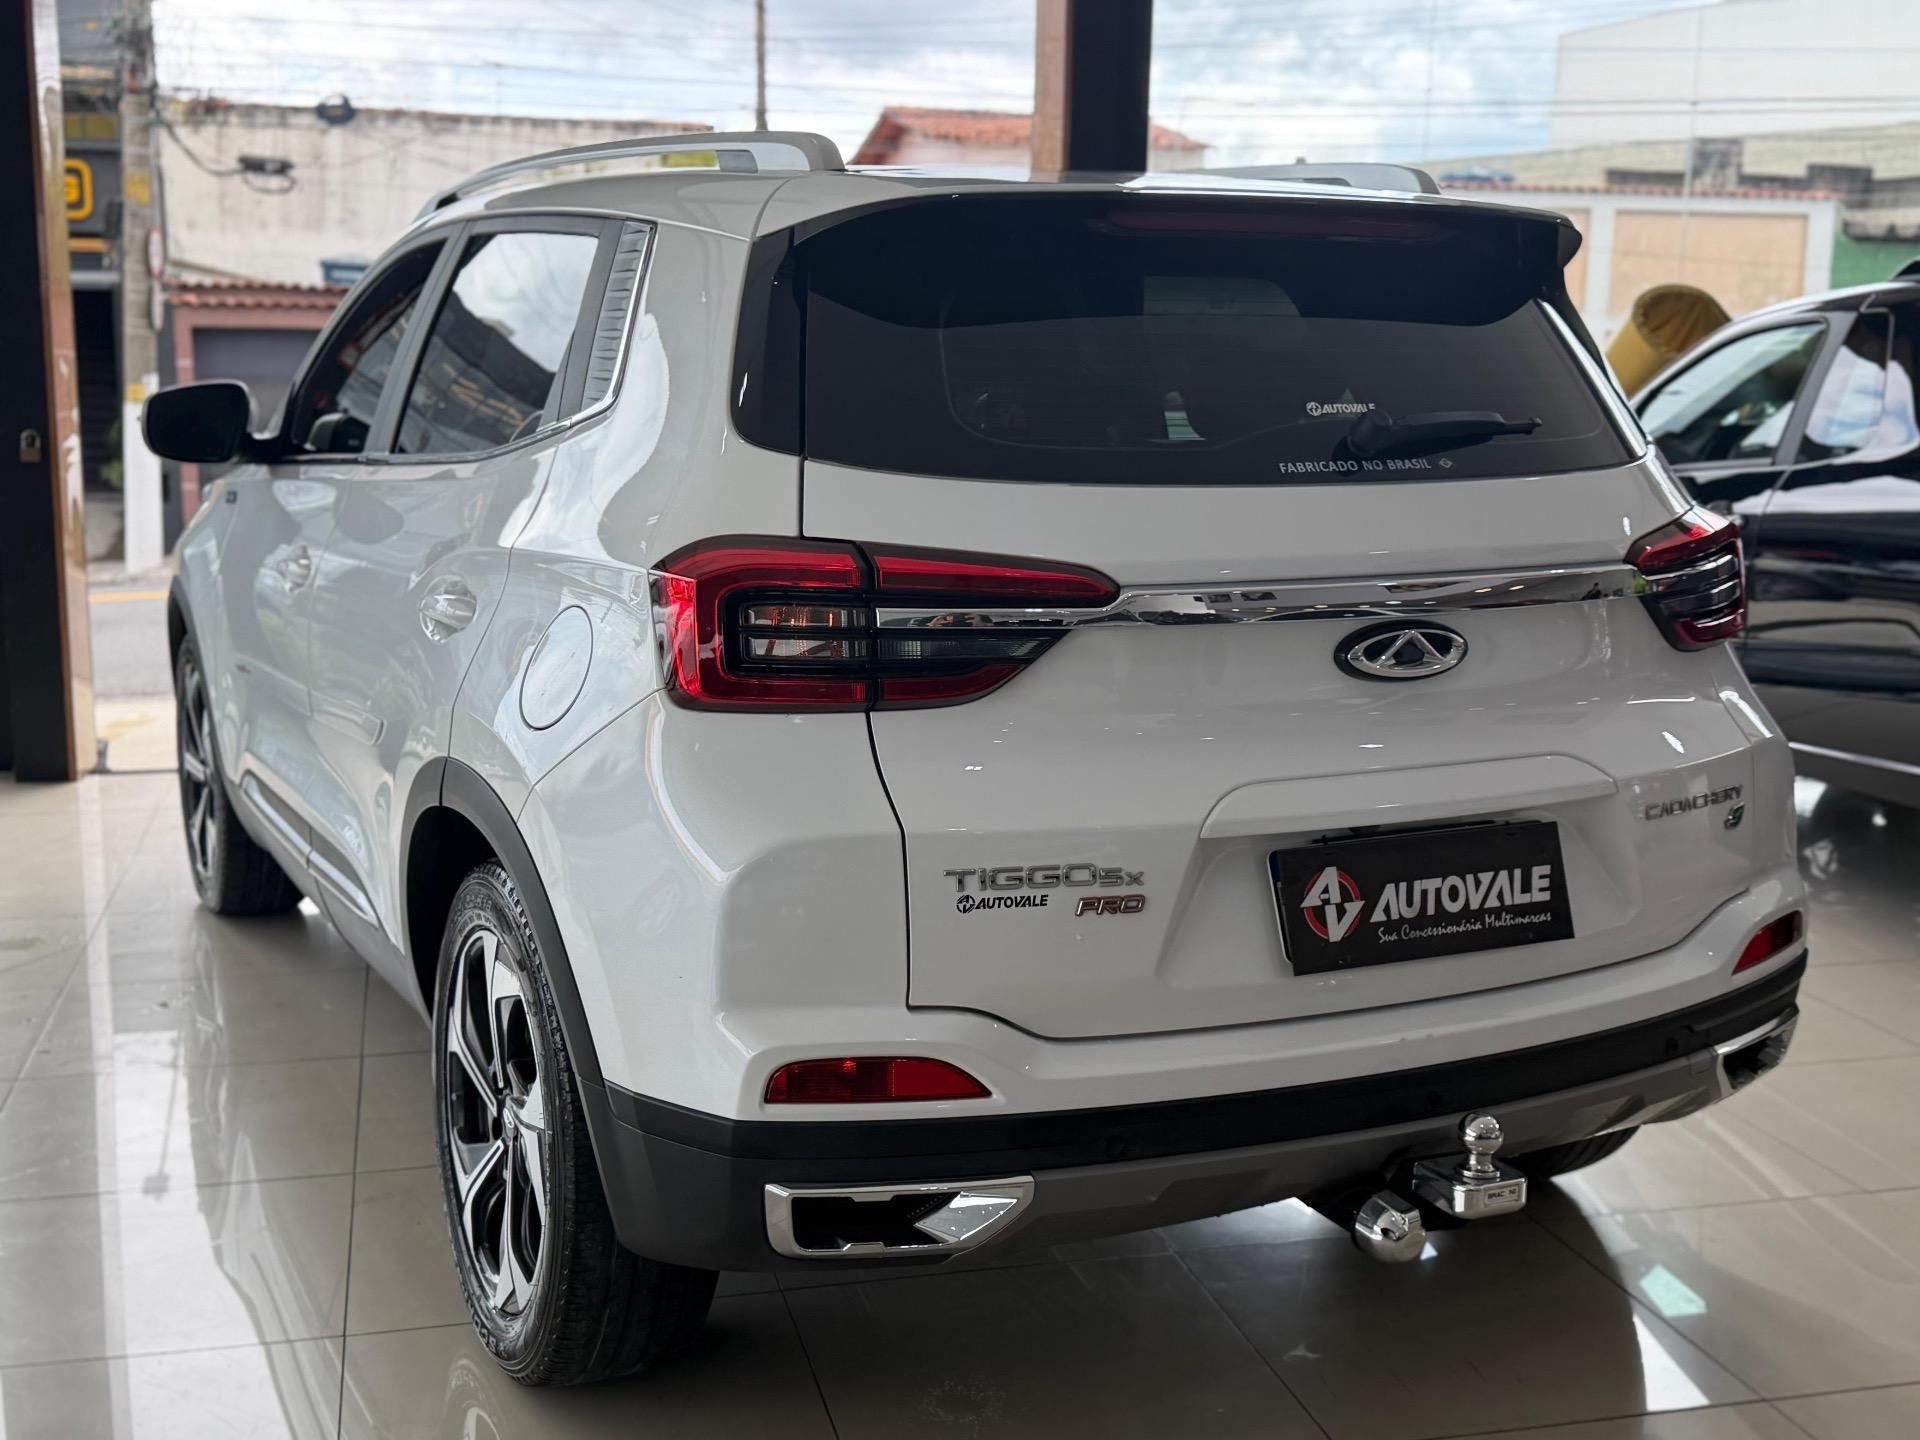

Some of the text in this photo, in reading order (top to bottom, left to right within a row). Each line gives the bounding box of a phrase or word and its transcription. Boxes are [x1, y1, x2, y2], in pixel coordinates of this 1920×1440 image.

[1278, 457, 1432, 474] FABRICADO NO BRASIL
[976, 894, 1049, 910] AUTOVALE
[1074, 893, 1146, 917] PRO
[1369, 864, 1552, 923] AUTOVALE
[1378, 910, 1552, 944] Sua Concessionária Multimarcas
